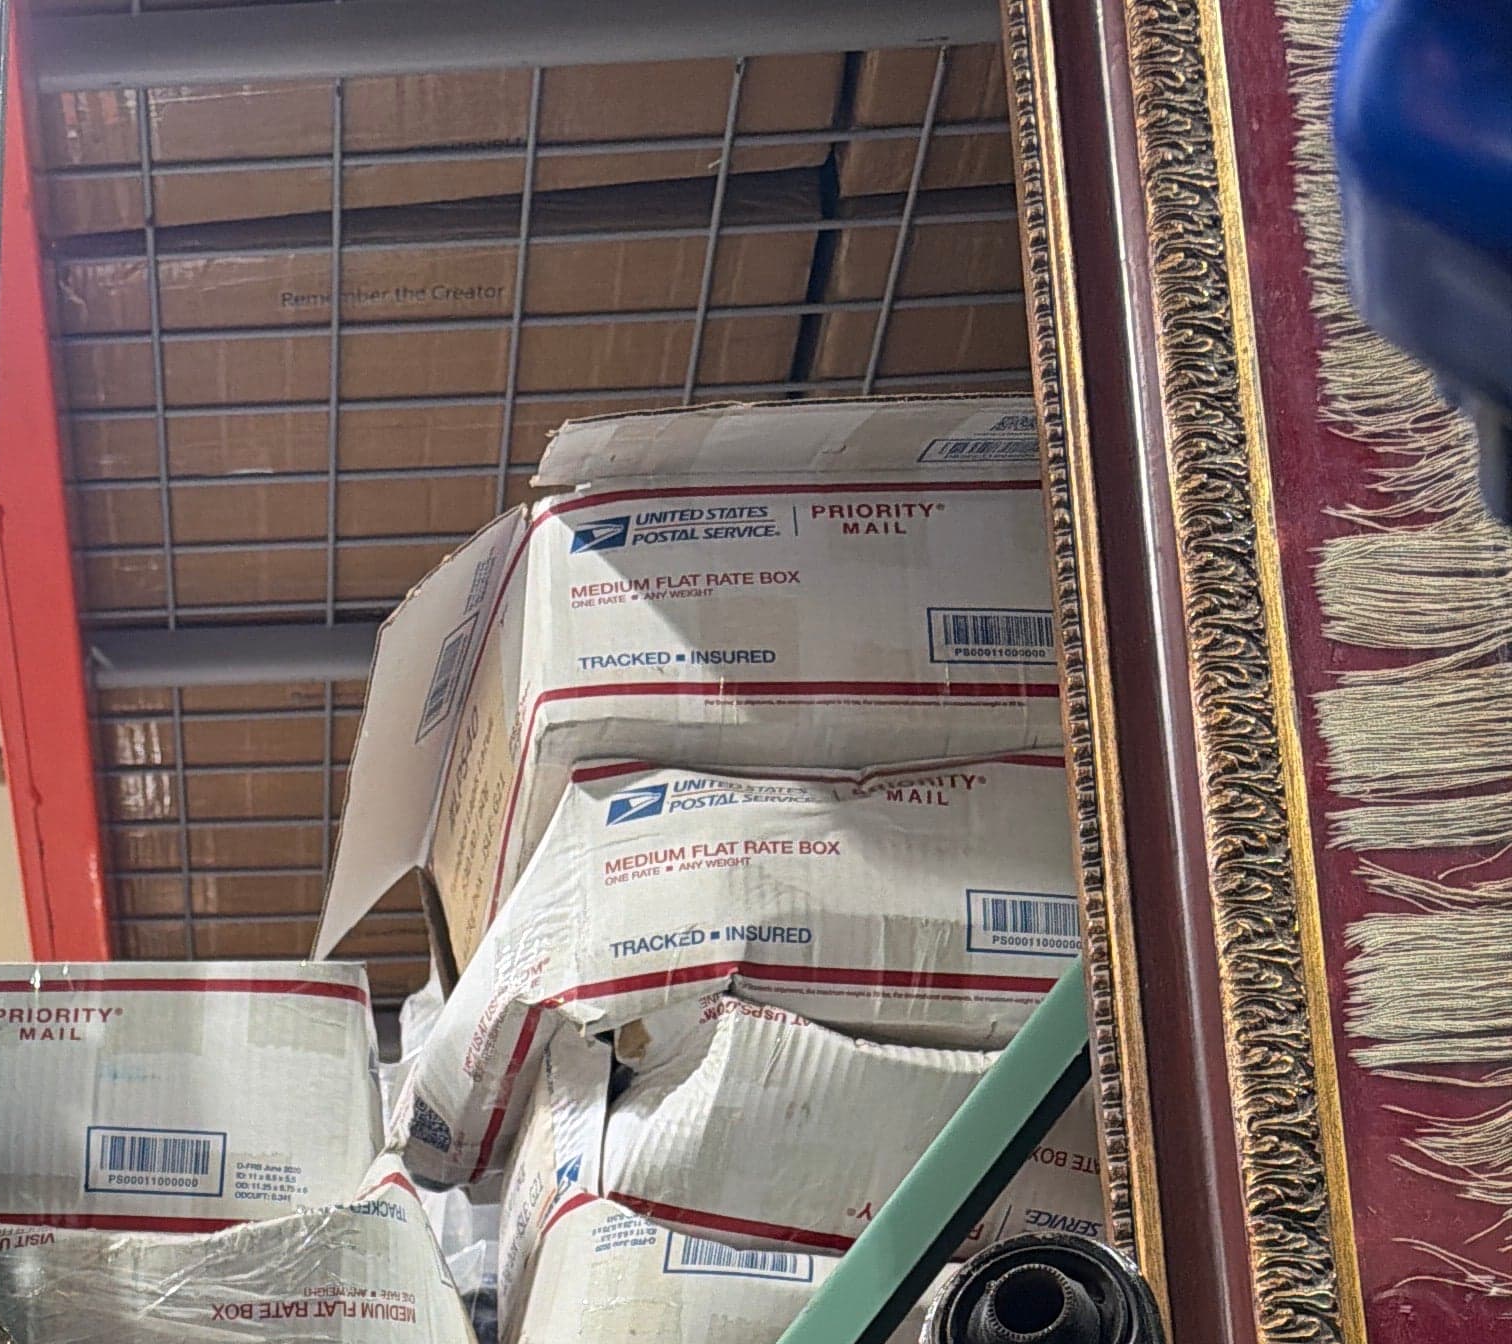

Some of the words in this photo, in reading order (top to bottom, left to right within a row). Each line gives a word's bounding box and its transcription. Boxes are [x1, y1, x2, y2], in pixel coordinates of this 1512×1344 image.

[635, 507, 705, 525] UNITED
[706, 506, 768, 521] STATES
[632, 526, 702, 545] POSTAL
[842, 521, 907, 535] MAIL
[571, 577, 650, 599] MEDIUM
[655, 573, 703, 590] FLAT
[705, 571, 755, 587] RATE
[759, 570, 801, 585] BOX
[578, 651, 671, 671] TRACKED
[691, 650, 776, 665] INSURED
[668, 793, 740, 813] POSTAL
[887, 789, 949, 806] MAIL
[604, 846, 686, 876] MEDIUM
[691, 842, 739, 859] FLAT
[744, 840, 794, 856] RATE
[798, 841, 841, 856] BOX
[604, 873, 630, 887] ONE
[632, 866, 660, 880] RATE
[678, 860, 703, 873] ANY
[704, 856, 752, 869] WEIGHT
[610, 929, 705, 958] TRACKED
[725, 926, 813, 944] INSURED
[19, 1027, 81, 1040] MAIL
[15, 1232, 56, 1249] VISIT
[211, 1300, 253, 1321] BOX
[259, 1300, 308, 1319] RATE
[313, 1302, 357, 1319] FLAT
[360, 1302, 416, 1323] MEDIUM
